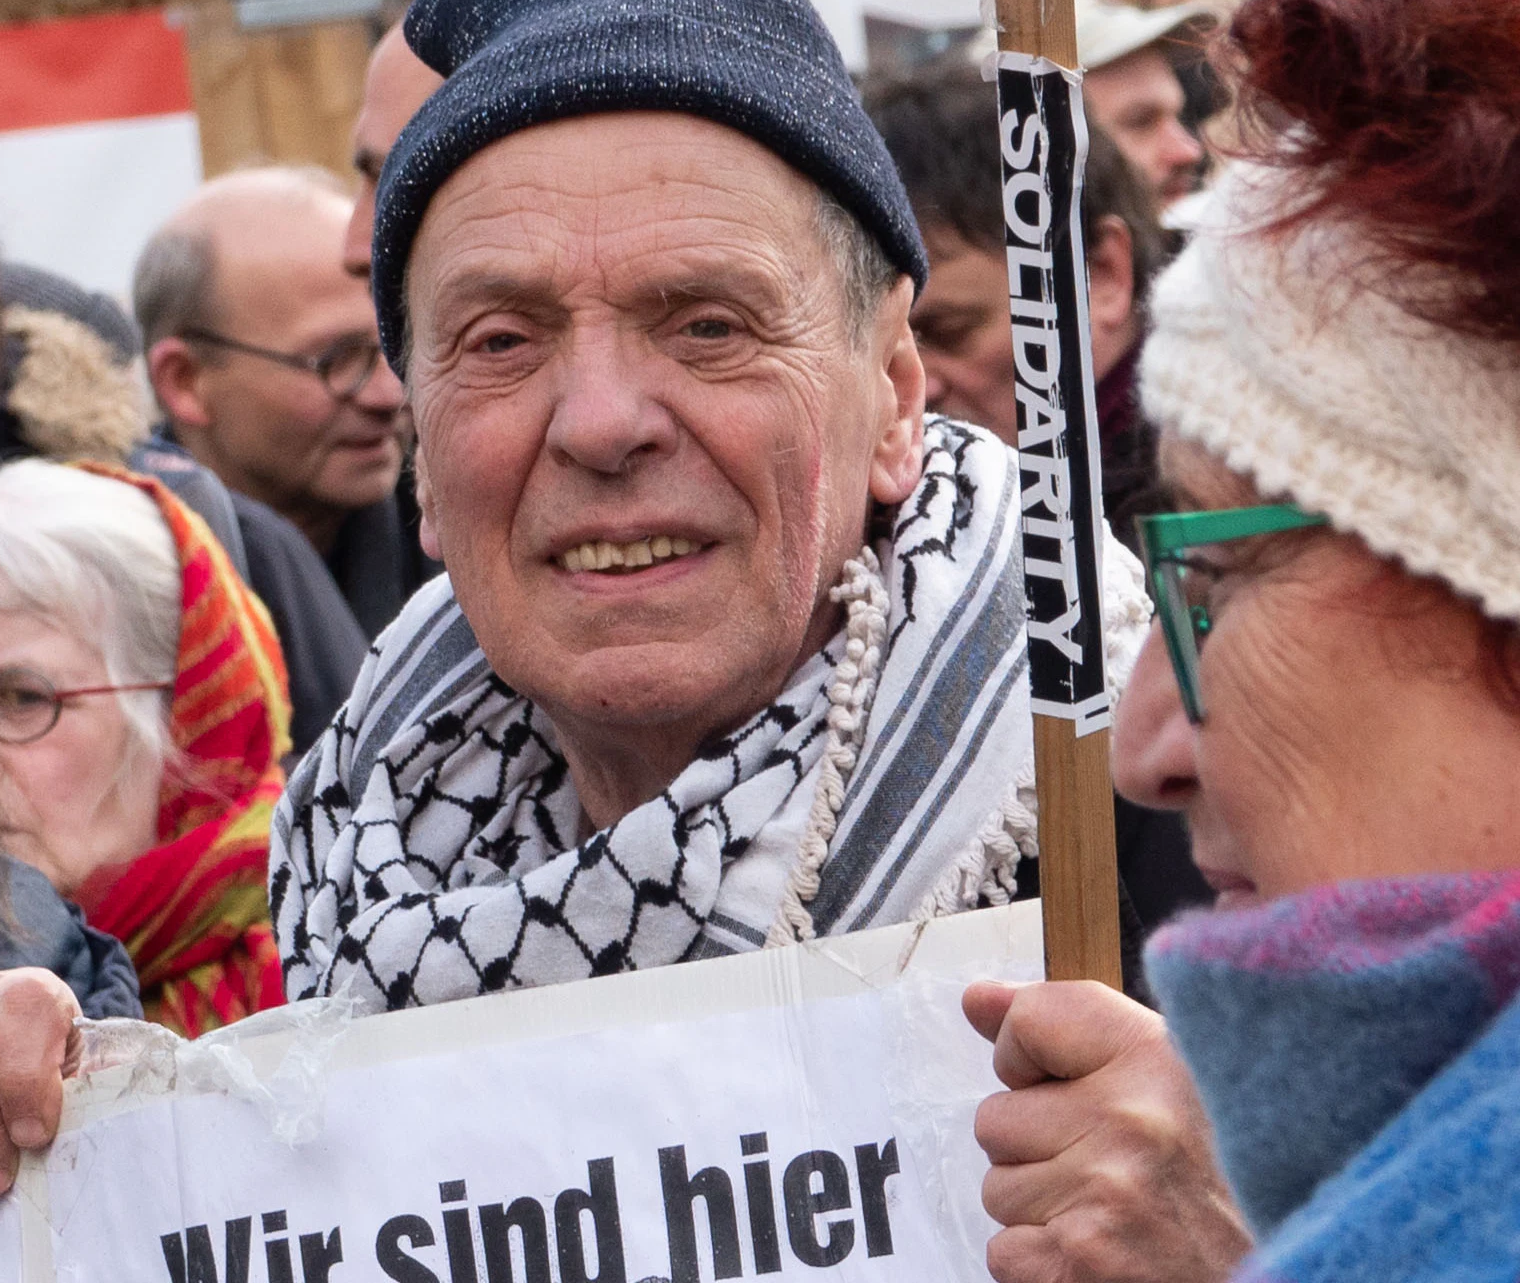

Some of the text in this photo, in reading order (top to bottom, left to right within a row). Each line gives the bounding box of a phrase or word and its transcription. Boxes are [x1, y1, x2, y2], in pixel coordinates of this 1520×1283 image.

[1000, 106, 1084, 666] SOLIDARITY
[375, 1156, 627, 1283] sind
[657, 1131, 900, 1283] hier
